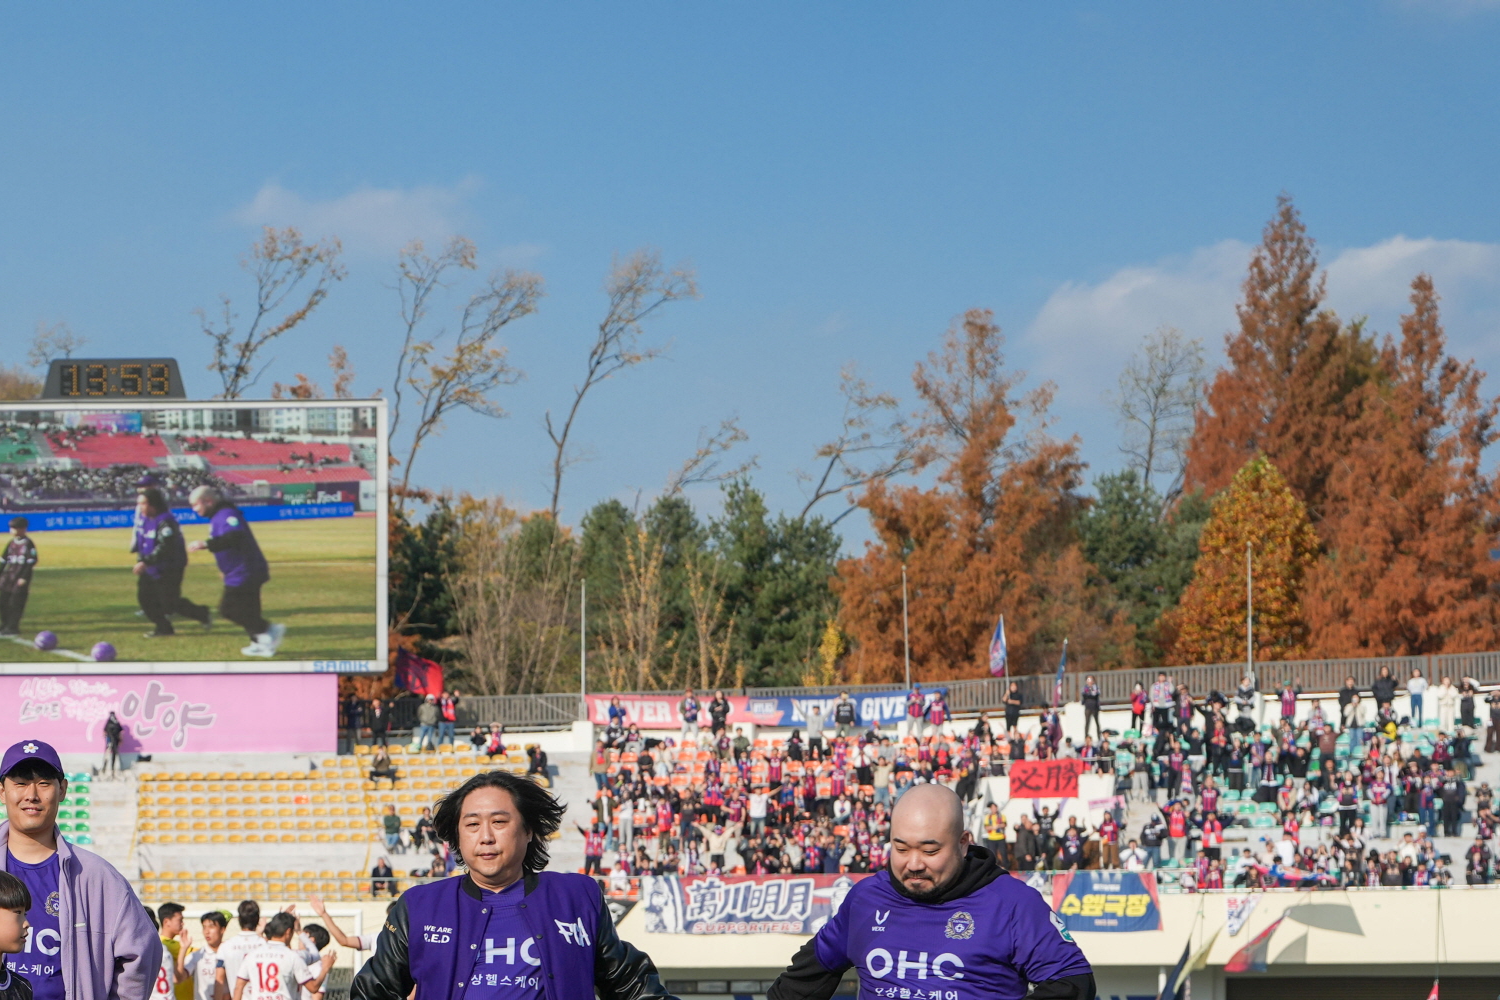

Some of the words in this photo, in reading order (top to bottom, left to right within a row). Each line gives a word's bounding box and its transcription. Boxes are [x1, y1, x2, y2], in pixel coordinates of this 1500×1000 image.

[69, 364, 169, 395] 13:58
[313, 660, 370, 672] SAMIK
[594, 699, 672, 722] NVER
[861, 695, 907, 721] GIVE
[1011, 761, 1080, 793] 必勝
[693, 920, 804, 934] SUPPORTERS
[256, 962, 280, 992] 18
[865, 948, 965, 981] OHC
